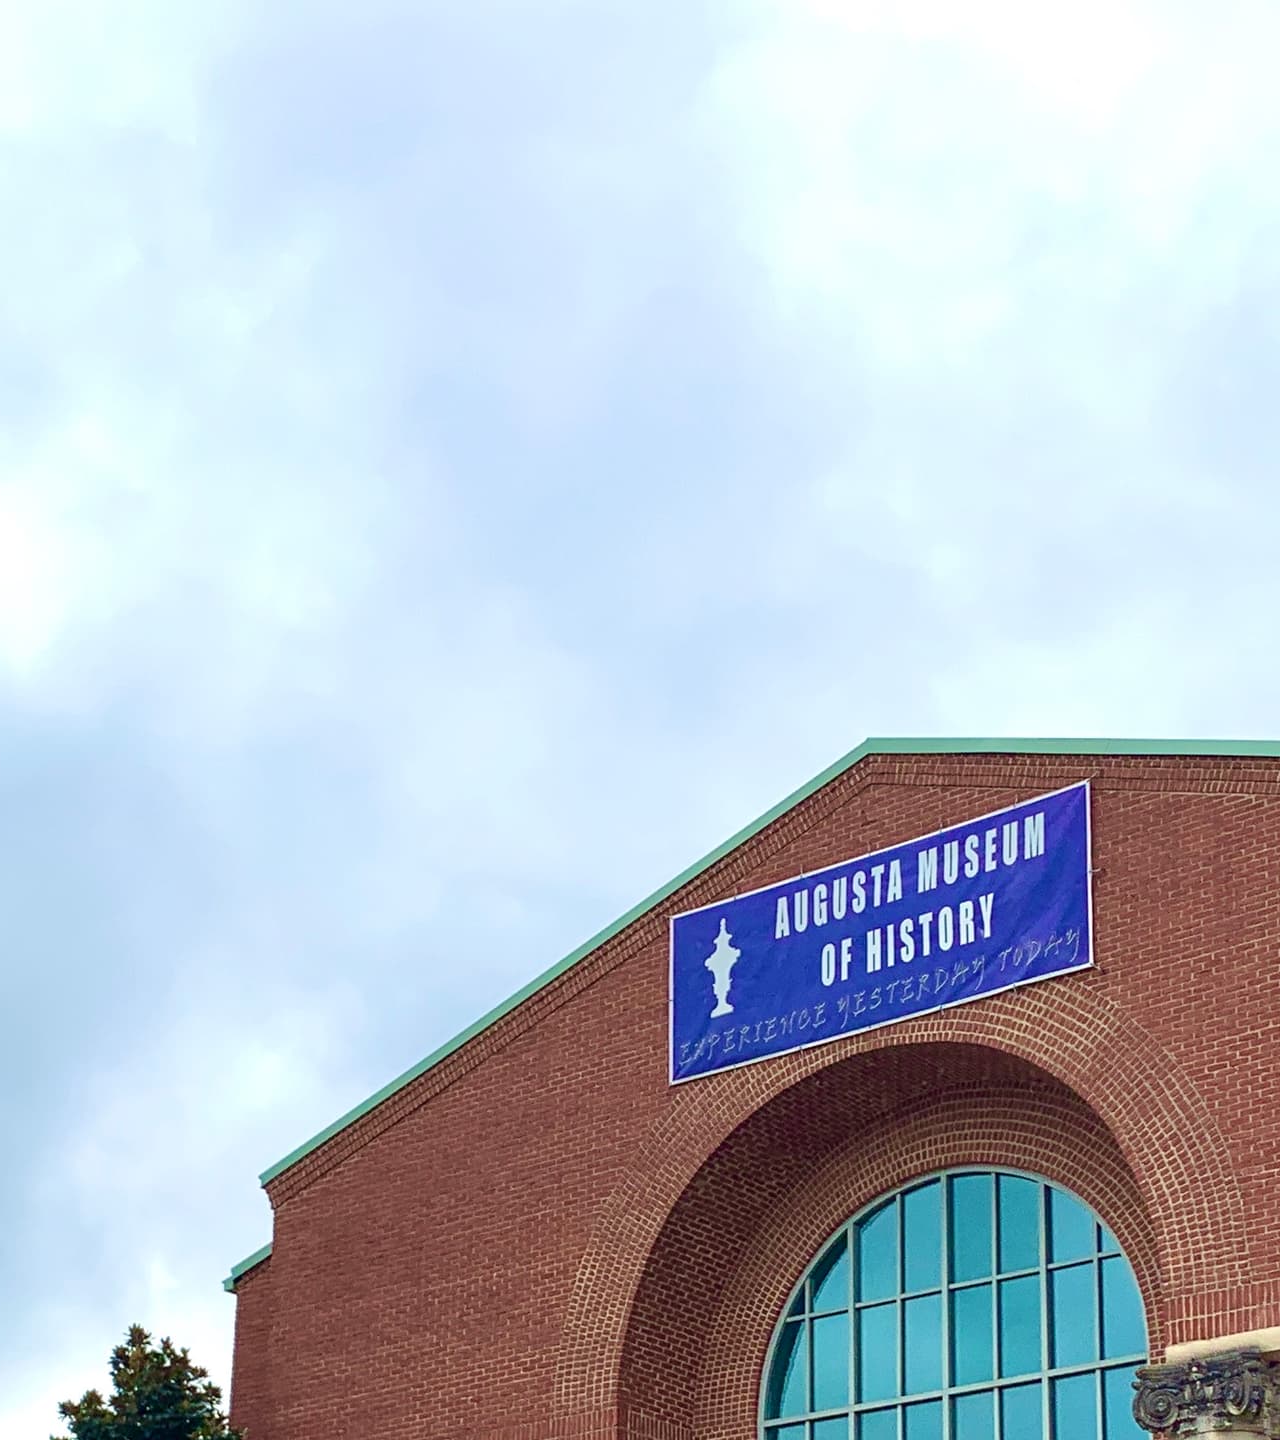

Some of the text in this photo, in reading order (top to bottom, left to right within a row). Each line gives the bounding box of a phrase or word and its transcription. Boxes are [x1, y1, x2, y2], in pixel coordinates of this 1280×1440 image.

[775, 812, 1045, 939] AUGUSTA MUSEUM
[679, 927, 1081, 1066] EXPERIENCE YESTERDAY TODAY
[821, 893, 994, 986] OF HISTORY
